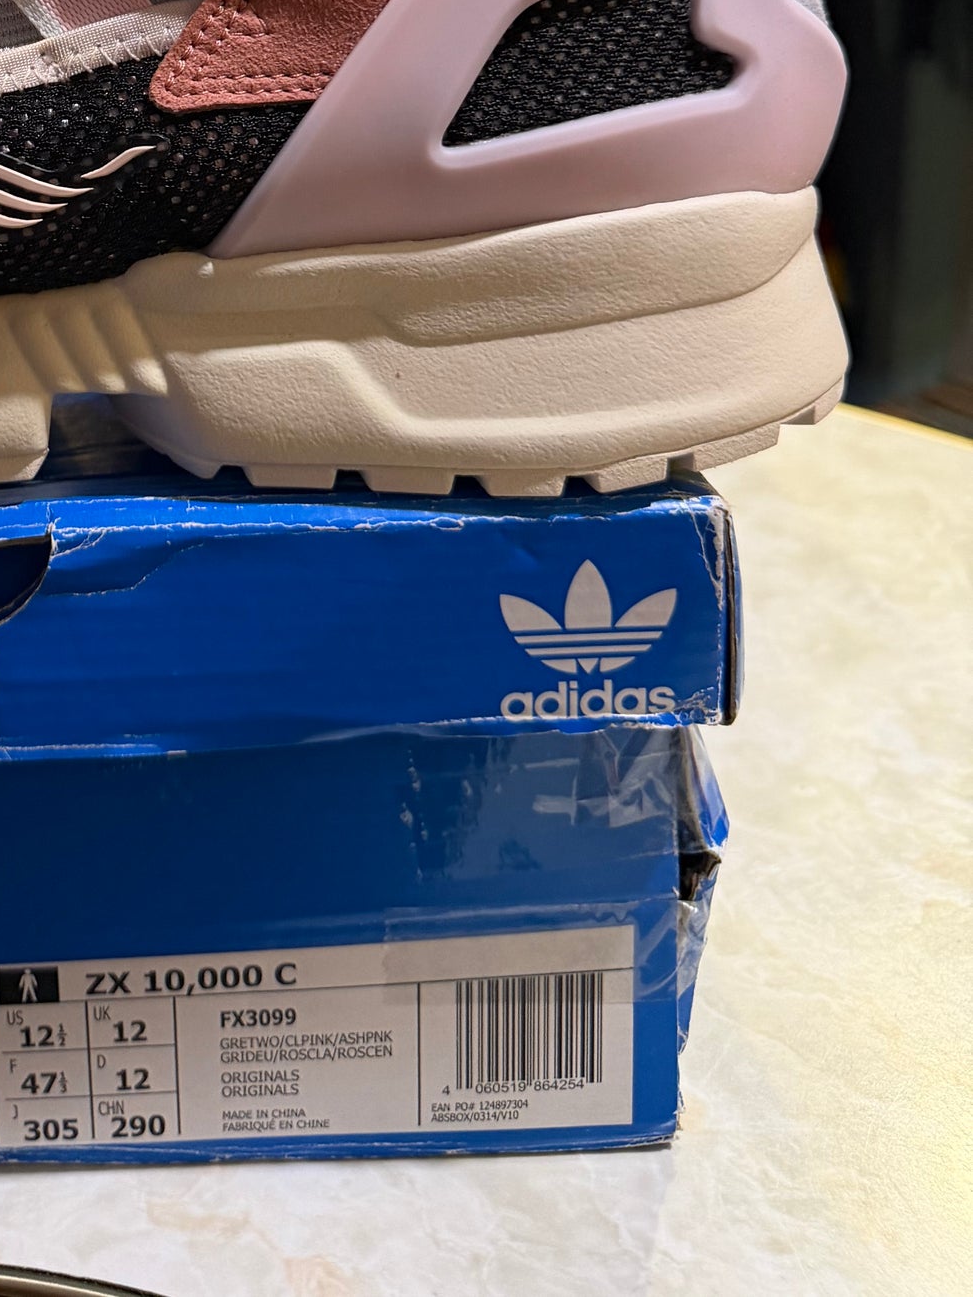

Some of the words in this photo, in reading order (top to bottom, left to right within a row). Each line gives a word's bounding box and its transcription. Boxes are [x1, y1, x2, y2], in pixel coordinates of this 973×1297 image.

[499, 679, 677, 721] adidas
[85, 972, 131, 995] ZX
[144, 964, 263, 996] 10,000
[274, 962, 297, 985] C
[6, 1010, 24, 1026] US
[93, 1005, 112, 1022] UK
[113, 1019, 148, 1043] 12
[220, 1008, 297, 1028] FX3099
[9, 1058, 18, 1074] F
[97, 1054, 106, 1069] D
[115, 1068, 151, 1091] 12
[221, 1069, 300, 1084] ORIGINALS
[221, 1083, 300, 1098] ORIGINALS
[442, 1085, 451, 1096] 4
[475, 1081, 527, 1094] 060519
[533, 1078, 585, 1092] 864254
[98, 1100, 125, 1116] CHN
[222, 1109, 253, 1120] MADE
[256, 1108, 269, 1119] IN
[271, 1107, 306, 1118] CHINA
[431, 1102, 451, 1112] EAN
[455, 1101, 475, 1111] PO#
[23, 1118, 79, 1141] 305
[111, 1114, 166, 1138] 290
[222, 1118, 276, 1133] FABRIQUÉ
[279, 1119, 293, 1130] EN
[296, 1118, 330, 1130] CHINE
